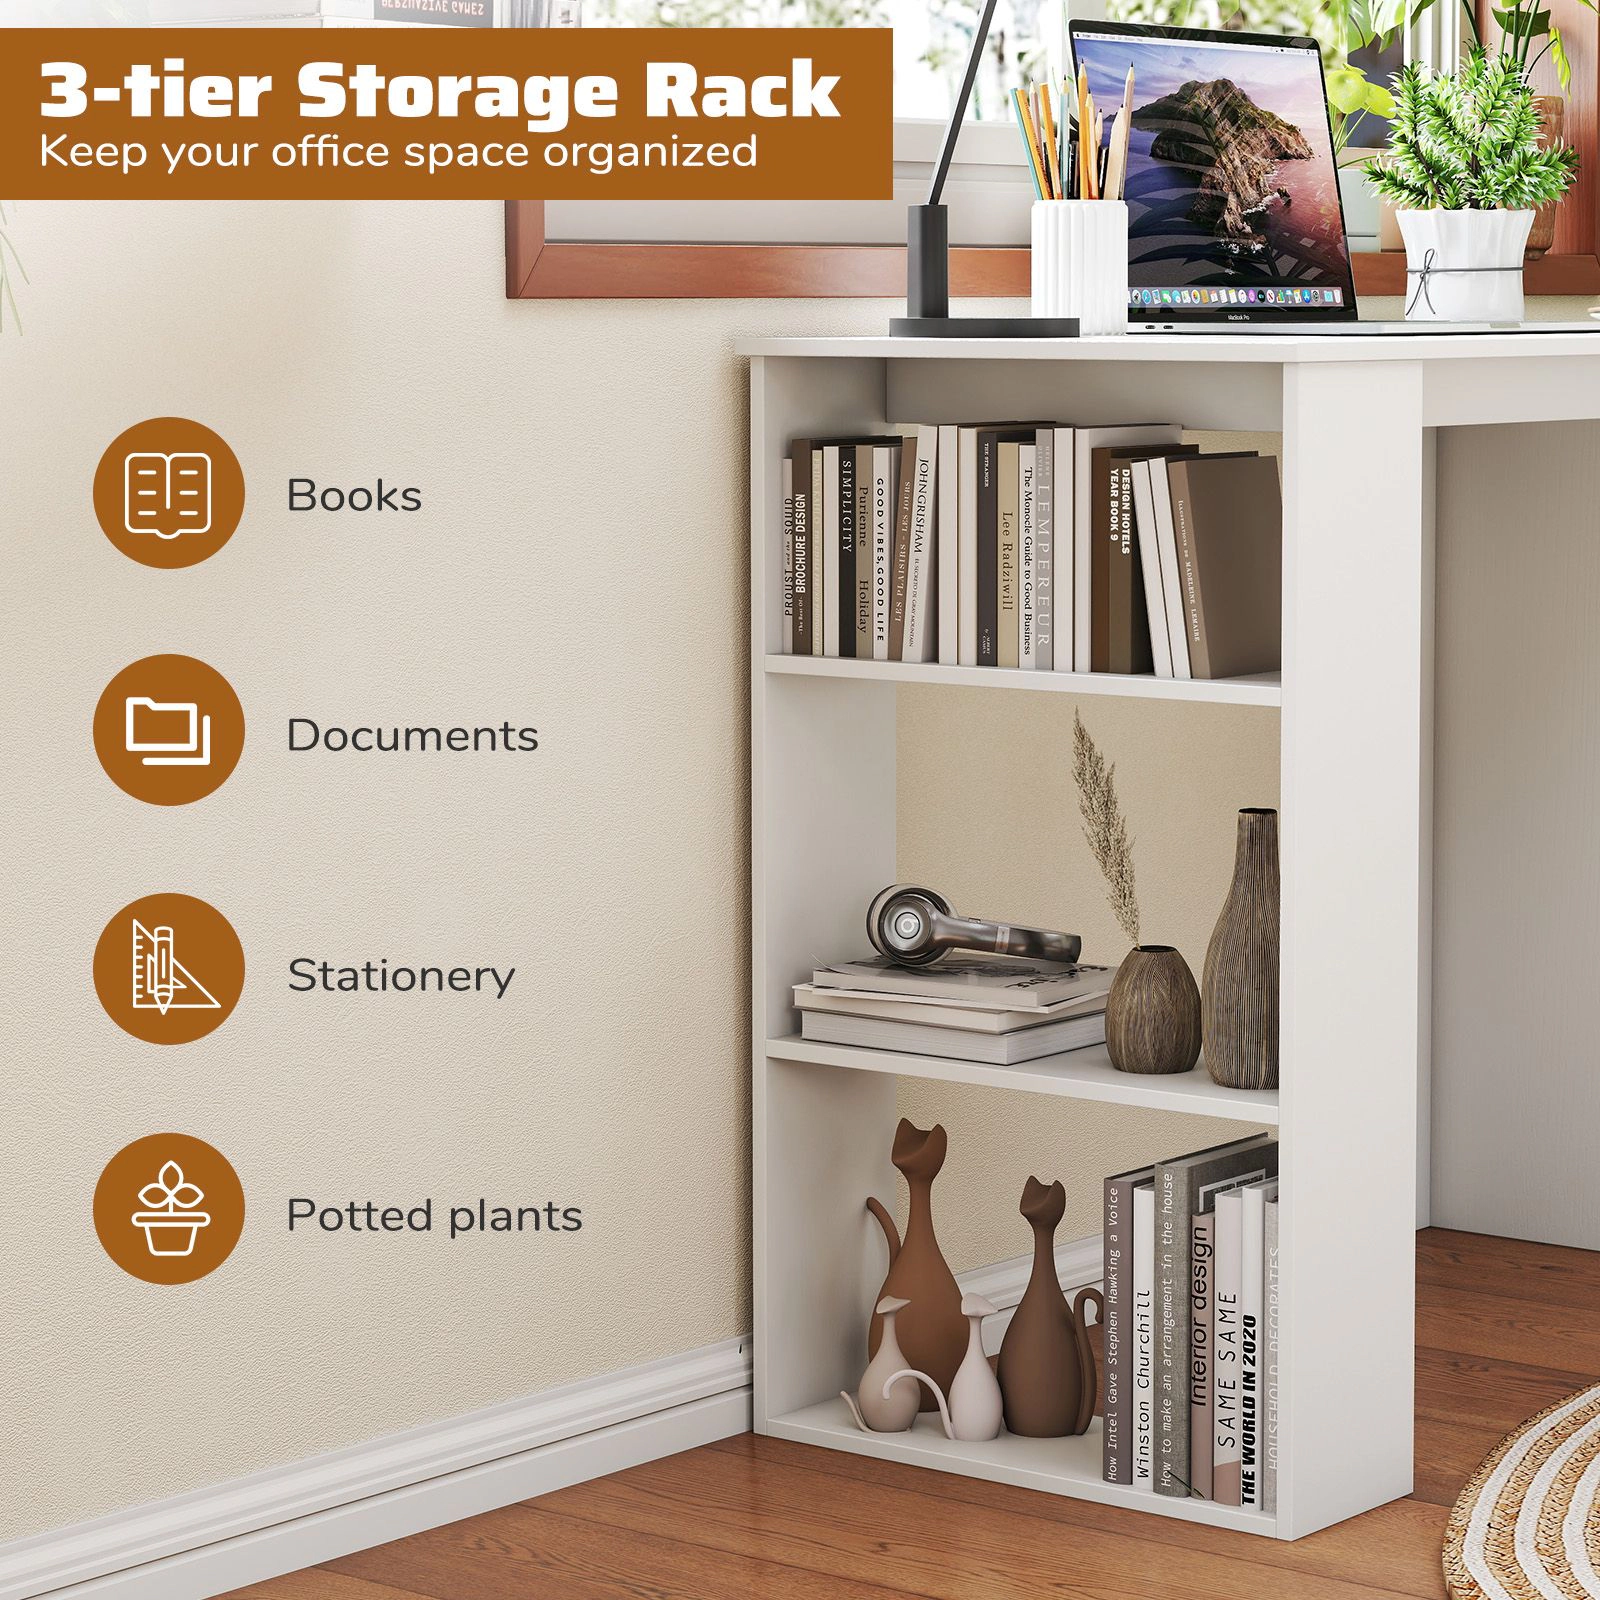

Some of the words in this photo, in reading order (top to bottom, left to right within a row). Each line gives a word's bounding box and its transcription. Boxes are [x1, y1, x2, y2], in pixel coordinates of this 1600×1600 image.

[903, 481, 911, 511] JOURS
[1024, 466, 1033, 488] The
[1110, 468, 1119, 497] YEAR
[1121, 468, 1131, 510] DESIGN
[784, 497, 793, 535] SQUID
[795, 493, 806, 533] DESIGN
[842, 460, 852, 553] SIMPLICITY
[859, 486, 869, 547] Purienne
[876, 478, 884, 518] GOOD
[1023, 490, 1033, 534] Monocle
[1110, 500, 1119, 532] BOOK
[1002, 511, 1013, 537] Lee
[1110, 533, 1119, 541] 9
[1121, 513, 1131, 555] HOTELS
[795, 535, 806, 594] BROCHURE
[896, 543, 906, 597] PLAISIRS
[1023, 536, 1033, 567] Guide
[1037, 484, 1050, 647] LEMPEREUR
[784, 568, 793, 616] PROUST
[1002, 543, 1014, 611] Radziwill
[1024, 569, 1032, 580] to
[857, 579, 870, 634] Holiday
[894, 601, 902, 622] LES
[1023, 581, 1033, 610] Good
[1185, 561, 1196, 605] MADELEINE
[1191, 608, 1201, 642] LEMAIRE
[876, 612, 884, 641] LIFE
[1023, 613, 1033, 656] Business
[1108, 1187, 1118, 1226] Voice
[1161, 1173, 1173, 1214] house
[1110, 1234, 1118, 1242] a
[1161, 1221, 1173, 1245] the
[1108, 1249, 1121, 1304] Hawking
[1161, 1254, 1173, 1270] in
[1191, 1226, 1213, 1310] design
[1107, 1311, 1120, 1366] Stephen
[1136, 1290, 1150, 1389] Churchill
[1161, 1279, 1176, 1367] arrangement
[1217, 1291, 1237, 1363] SAME
[1242, 1314, 1257, 1367] 2020
[1190, 1317, 1207, 1407] Interior
[1242, 1370, 1256, 1392] IN
[1107, 1372, 1118, 1404] Gave
[1162, 1374, 1172, 1391] an
[1107, 1411, 1117, 1450] Intel
[1160, 1398, 1172, 1432] make
[1217, 1377, 1236, 1449] SAME
[1241, 1395, 1256, 1466] WORLD
[1136, 1401, 1150, 1478] Winston
[1161, 1438, 1172, 1454] to
[1107, 1456, 1117, 1481] How
[1160, 1461, 1172, 1487] How
[1241, 1469, 1256, 1505] THE
